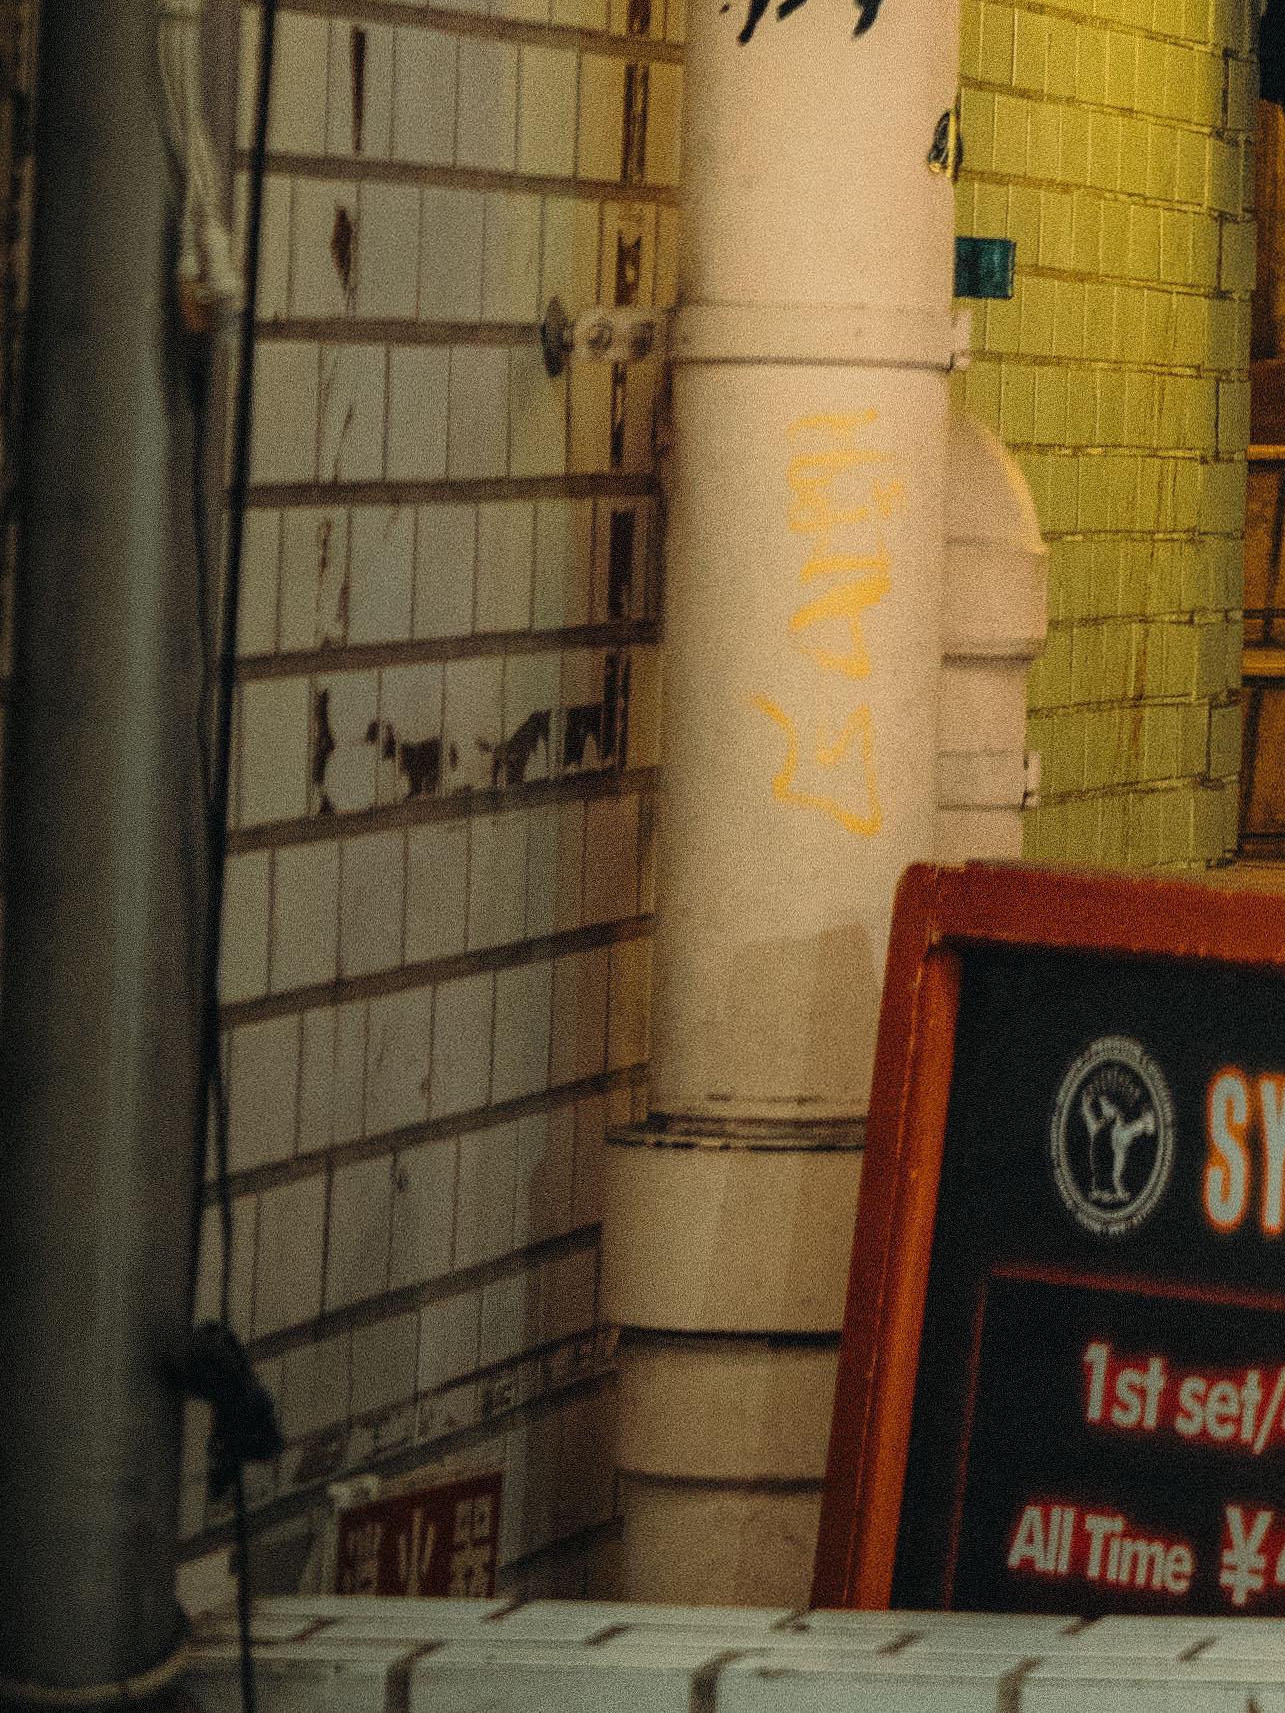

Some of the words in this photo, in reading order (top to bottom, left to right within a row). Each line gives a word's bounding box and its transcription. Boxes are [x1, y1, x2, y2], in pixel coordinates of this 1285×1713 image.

[1083, 1340, 1167, 1429] 1st
[1006, 1504, 1073, 1574] All
[1082, 1514, 1193, 1595] Time
